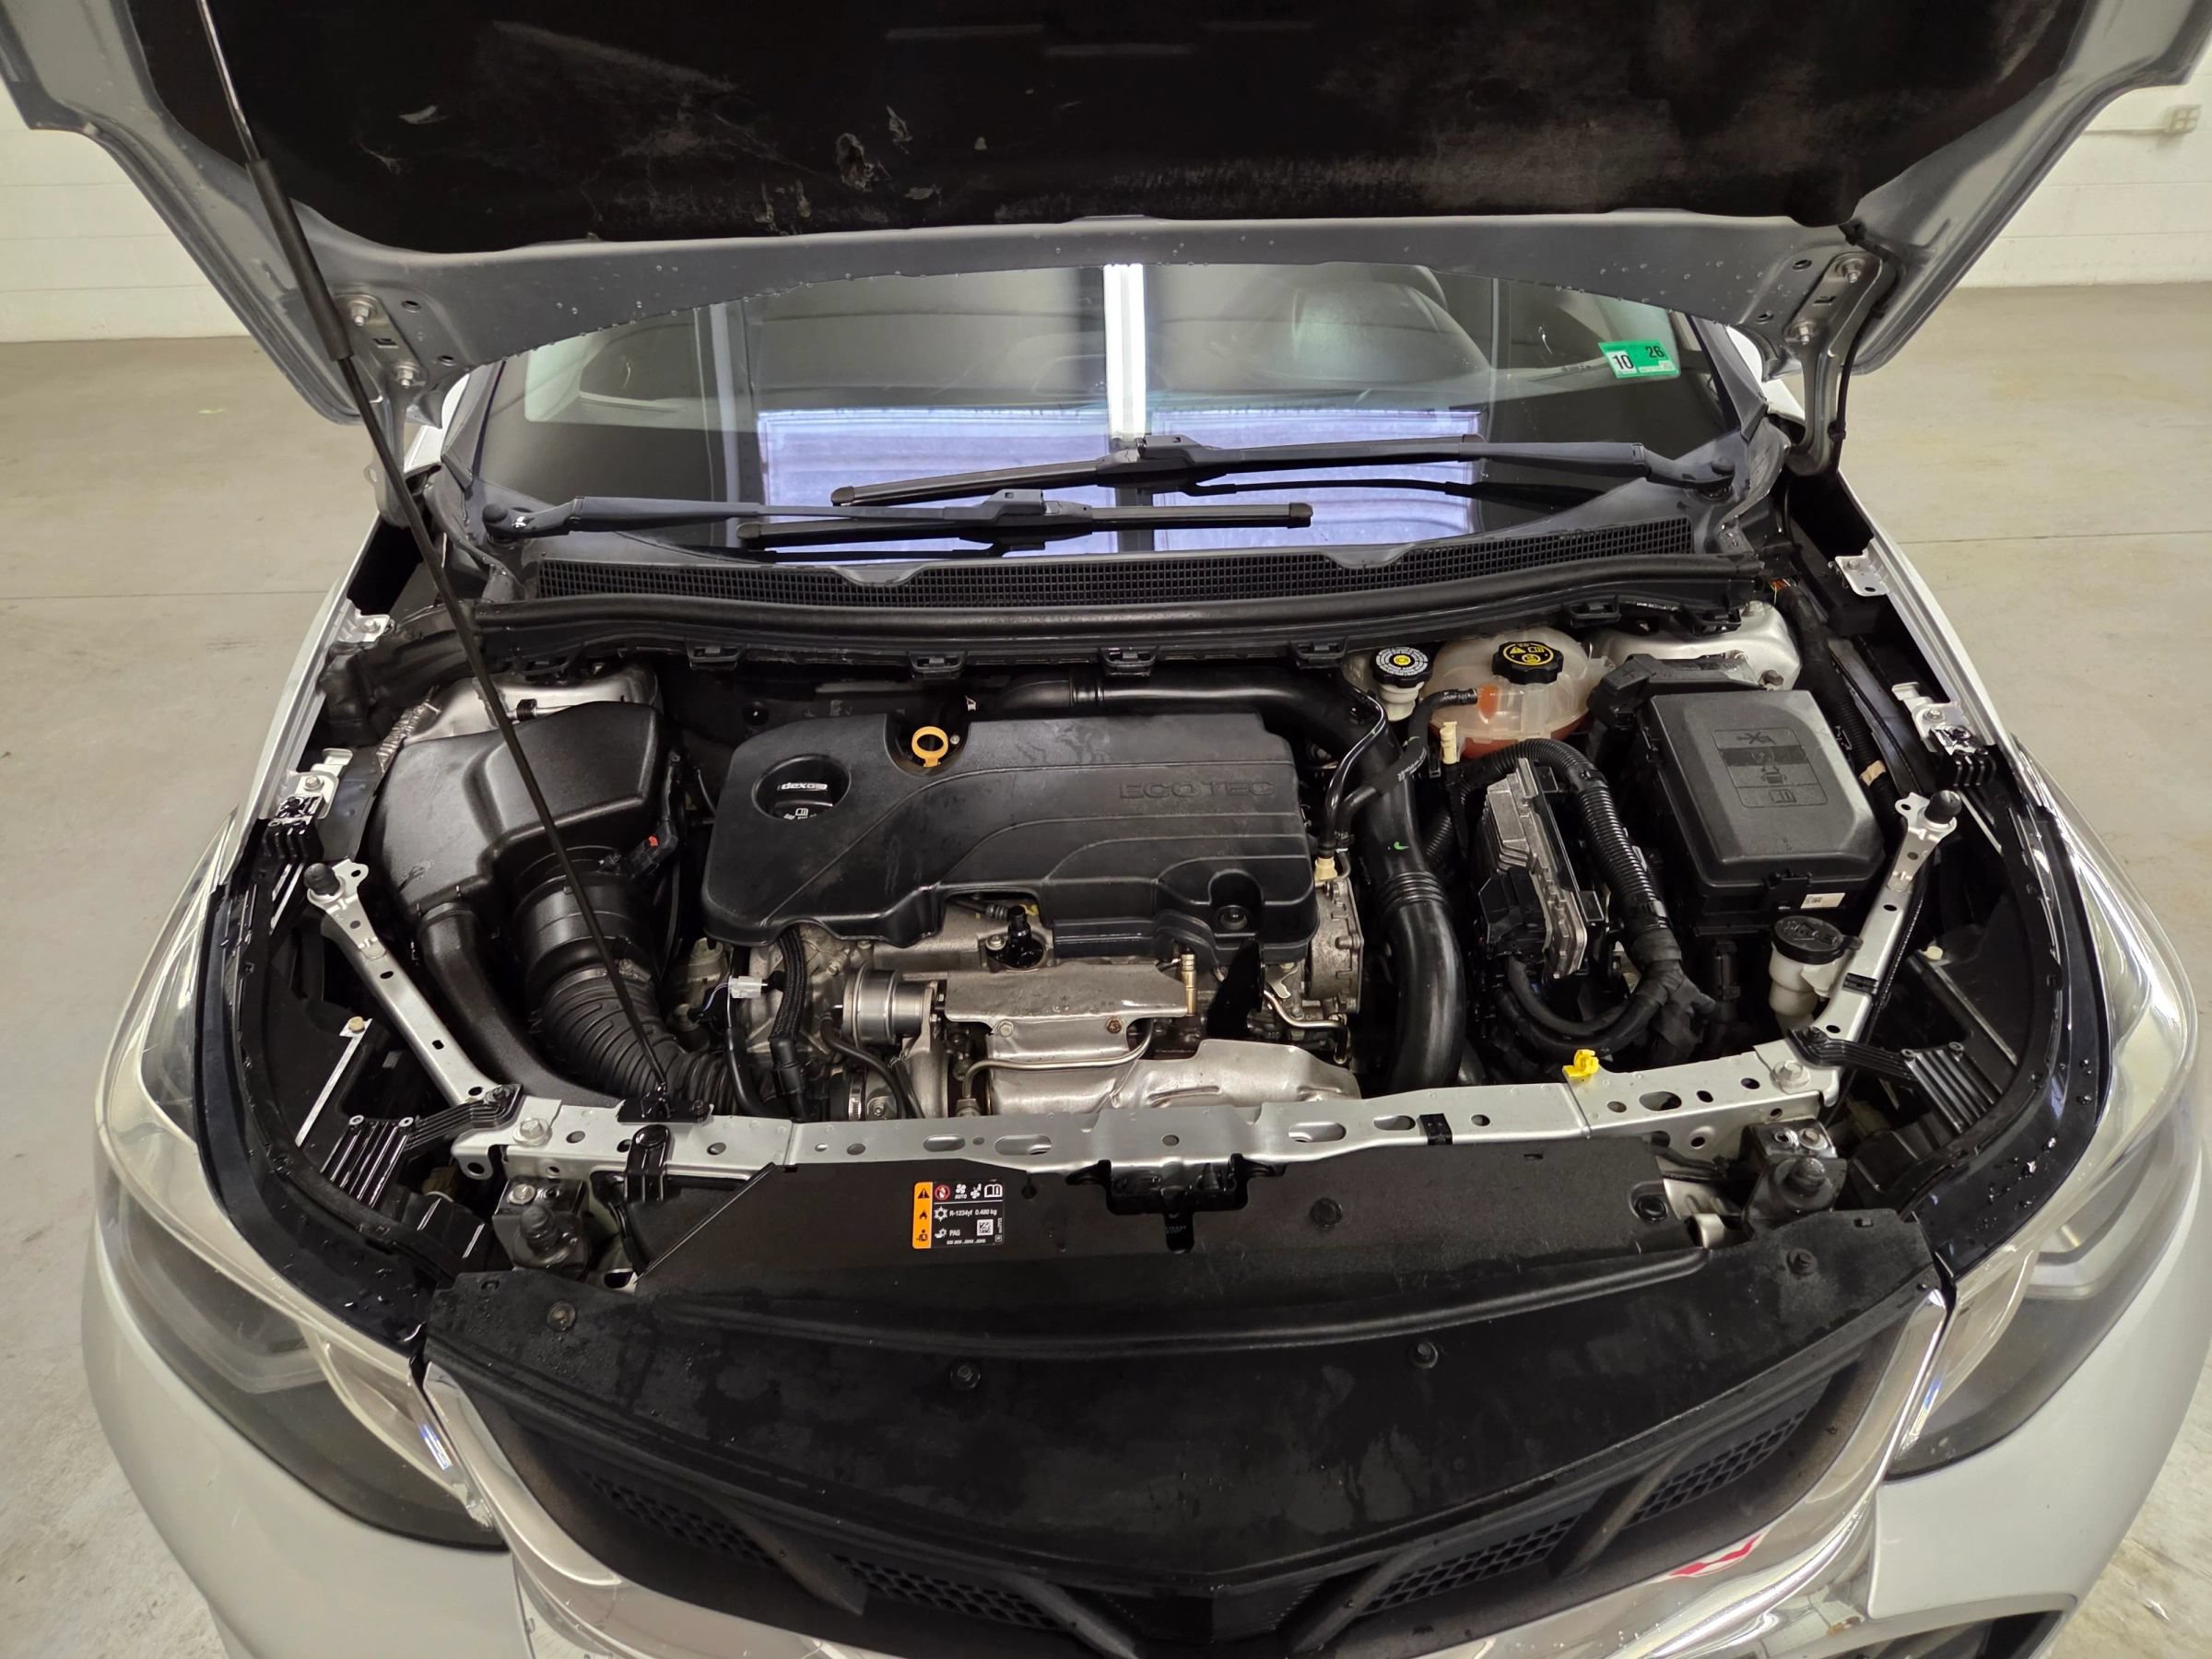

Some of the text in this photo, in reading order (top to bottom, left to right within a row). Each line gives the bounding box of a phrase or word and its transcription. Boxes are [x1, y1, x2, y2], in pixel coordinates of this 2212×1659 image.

[1645, 345, 1665, 359] 26
[1612, 354, 1634, 370] 10
[1119, 781, 1276, 799] ECOTEC
[990, 1208, 997, 1217] kg
[948, 1229, 961, 1237] PAG
